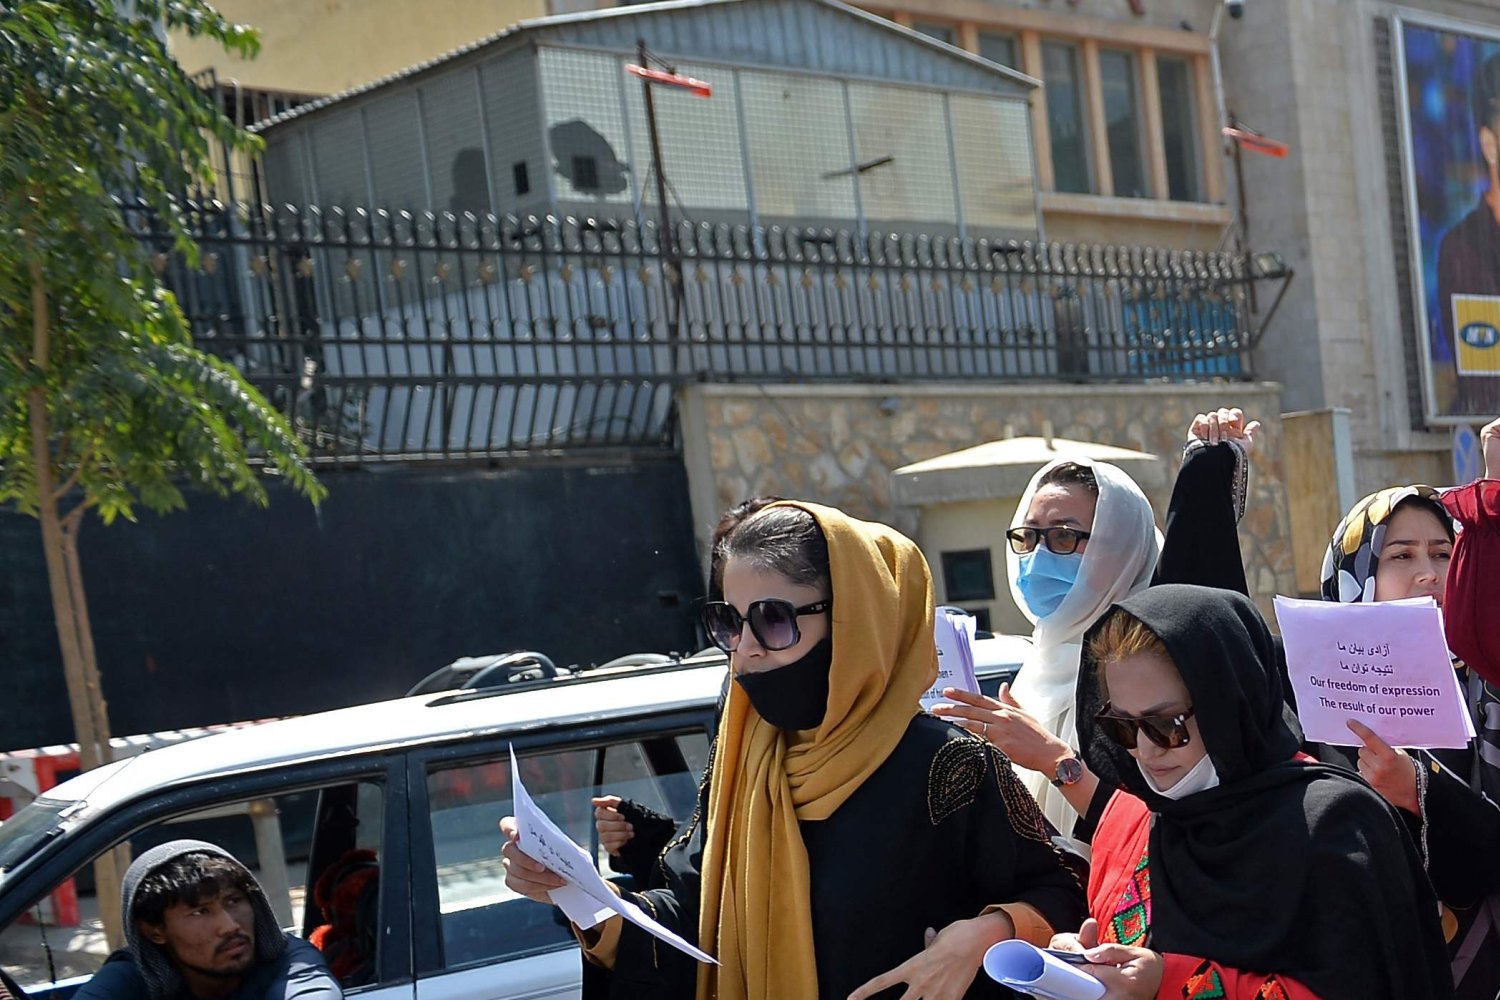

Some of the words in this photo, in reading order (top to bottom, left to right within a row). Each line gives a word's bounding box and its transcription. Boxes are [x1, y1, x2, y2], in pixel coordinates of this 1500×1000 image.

[1337, 641, 1346, 651] ما
[1348, 642, 1365, 656] بیان
[1367, 643, 1390, 657] آزادی
[1339, 660, 1349, 670] ما
[1351, 663, 1369, 675] توان
[1310, 676, 1326, 688] Our
[1327, 678, 1368, 693] freedom
[1369, 684, 1379, 695] of
[1381, 685, 1441, 698] expression
[1319, 696, 1337, 709] The
[1338, 700, 1365, 713] result
[1366, 704, 1376, 714] of
[1378, 706, 1397, 716] our
[1400, 707, 1435, 718] power
